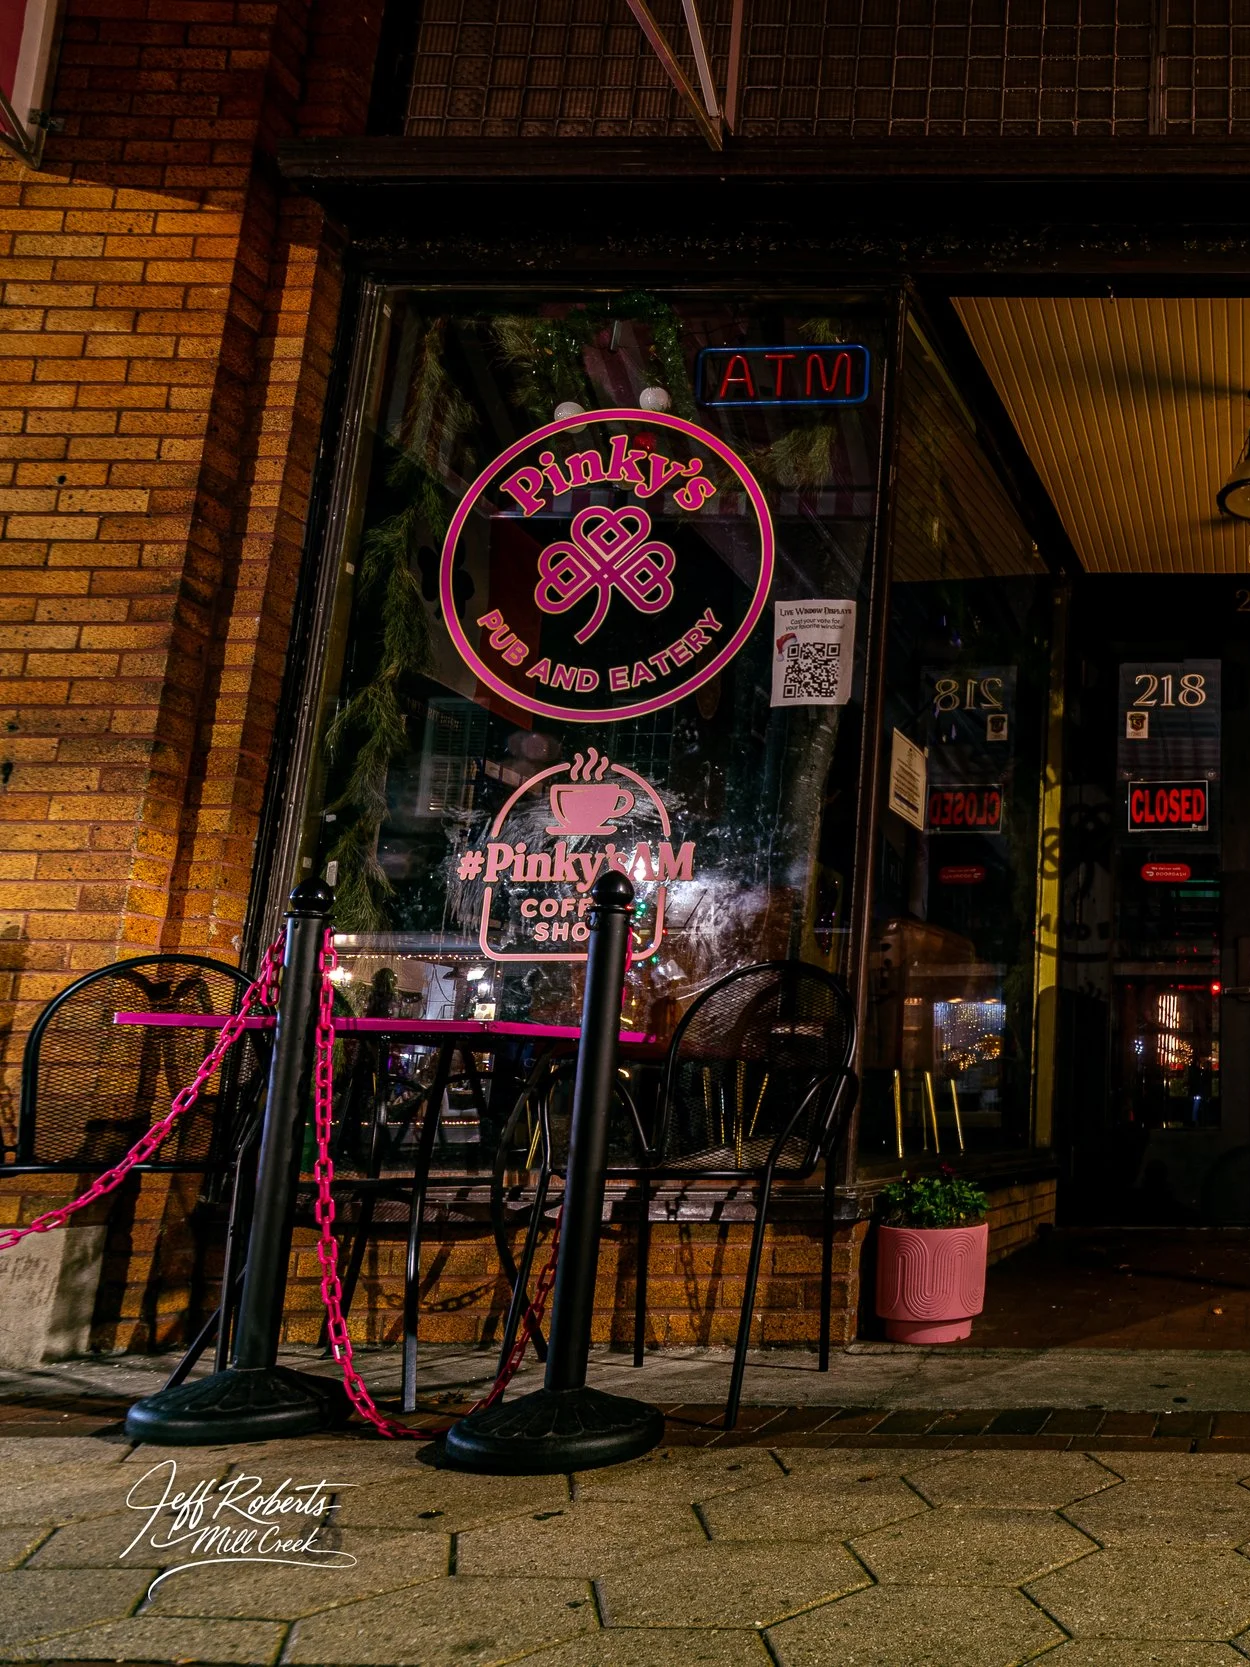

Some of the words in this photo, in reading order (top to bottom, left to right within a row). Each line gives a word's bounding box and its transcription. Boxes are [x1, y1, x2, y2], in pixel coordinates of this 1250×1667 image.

[719, 352, 851, 399] ATM
[499, 434, 717, 517] Pinky's
[476, 608, 530, 667] PUB
[525, 657, 600, 693] AND
[608, 607, 723, 692] EATERY
[1132, 673, 1207, 707] 218
[1130, 788, 1206, 824] CLOSED
[456, 841, 697, 893] #Pinky'sAM
[520, 897, 595, 918] COFF
[533, 921, 591, 942] SHO
